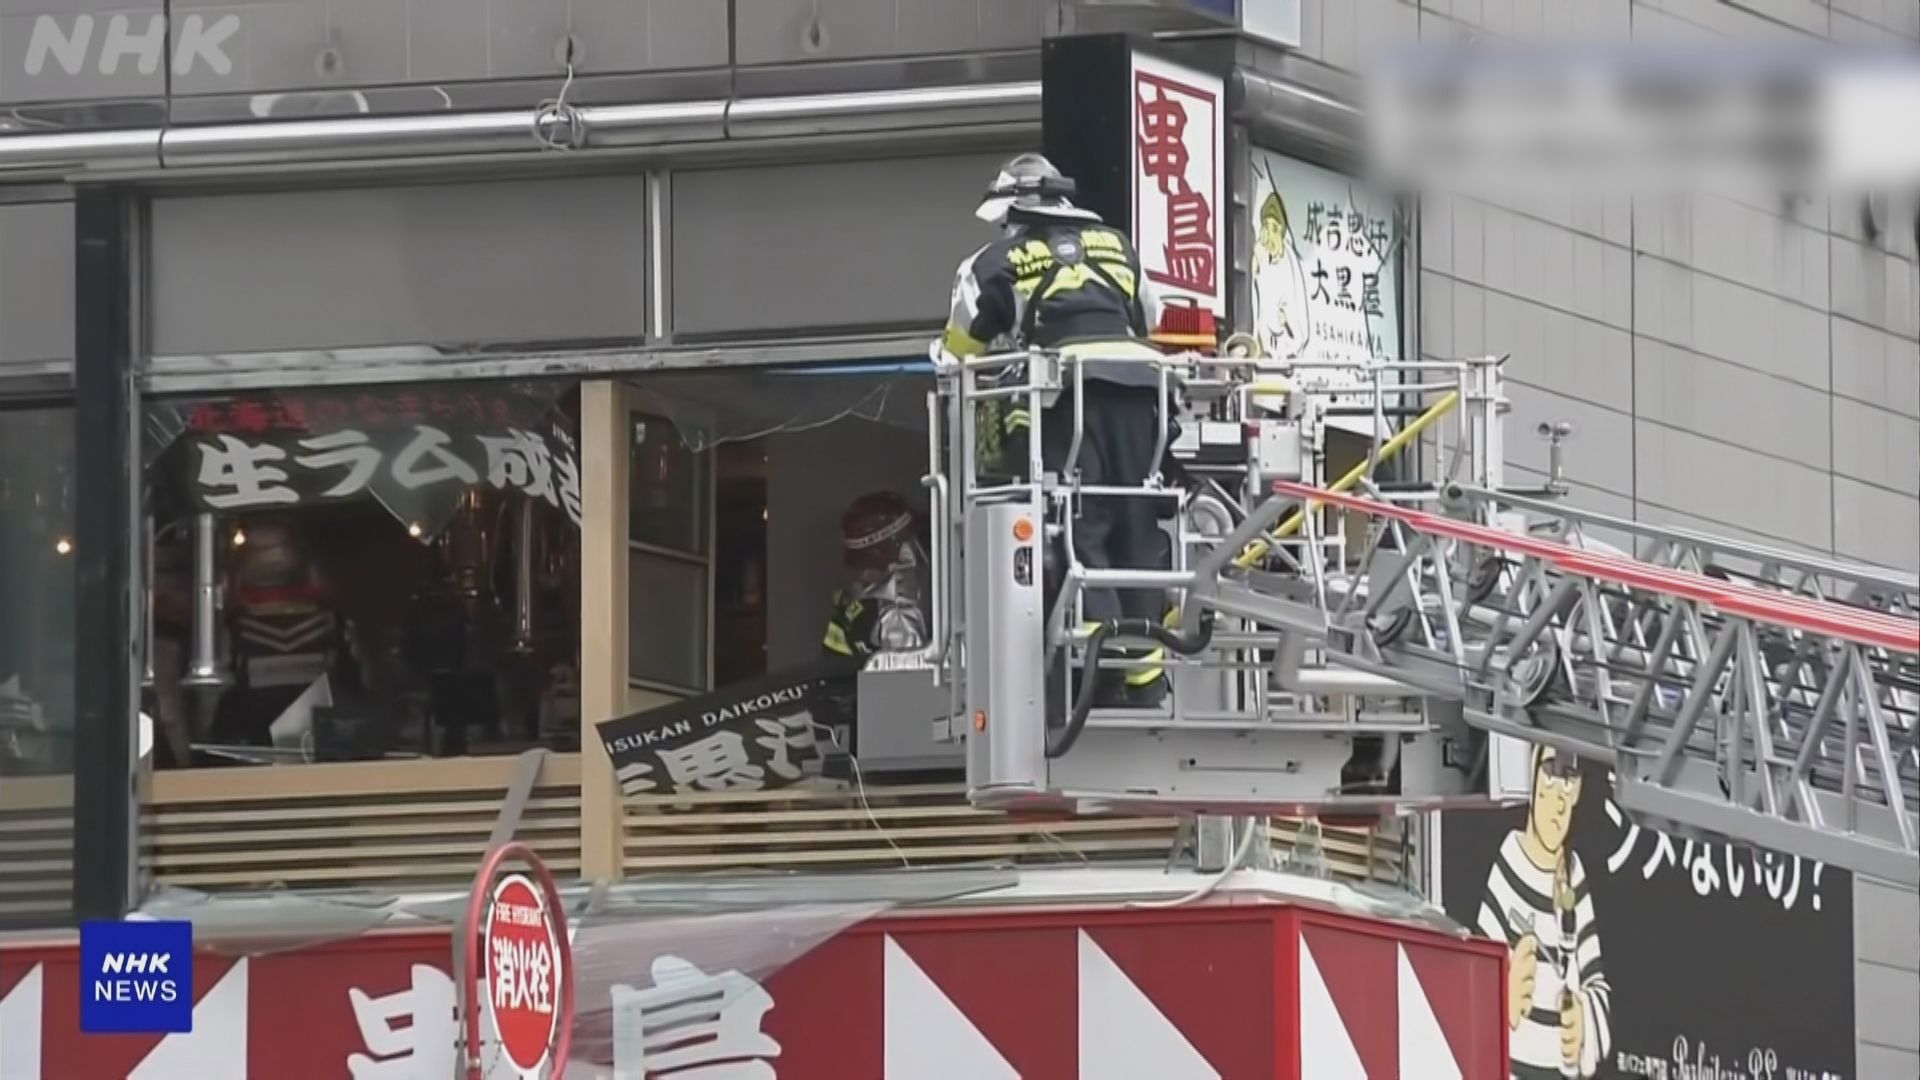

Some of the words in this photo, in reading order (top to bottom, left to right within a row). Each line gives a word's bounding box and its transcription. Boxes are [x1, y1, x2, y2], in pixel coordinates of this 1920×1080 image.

[1137, 85, 1214, 285] 串鳥
[1311, 258, 1384, 318] 大黒屋
[702, 684, 809, 728] DAIKOKU
[492, 935, 552, 1013] 消火栓
